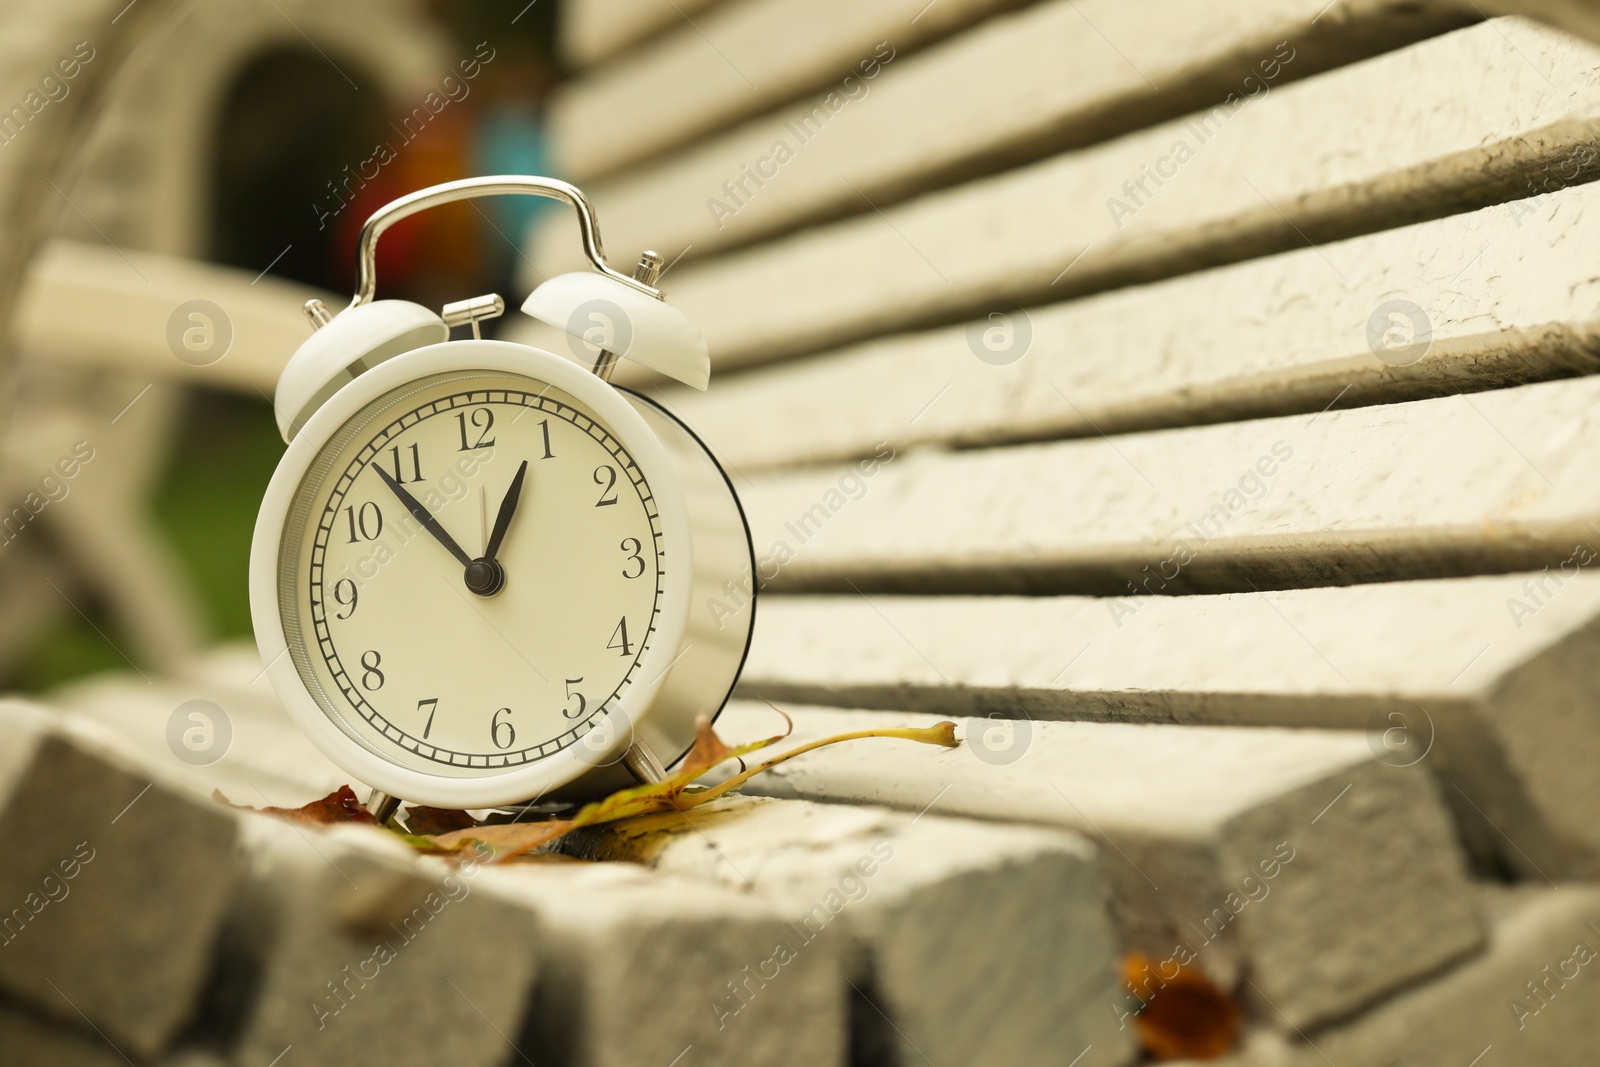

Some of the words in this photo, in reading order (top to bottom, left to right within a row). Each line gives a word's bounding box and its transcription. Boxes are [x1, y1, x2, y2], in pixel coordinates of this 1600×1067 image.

[454, 408, 496, 452] 12
[537, 419, 556, 459] 1
[388, 442, 426, 484] 11
[594, 465, 618, 507] 2
[344, 502, 383, 543] 10
[620, 538, 645, 579] 3
[334, 578, 358, 619] 9
[607, 616, 634, 656] 4
[360, 651, 385, 691] 8
[417, 698, 438, 739] 7
[562, 677, 586, 719] 5
[490, 708, 516, 749] 6
